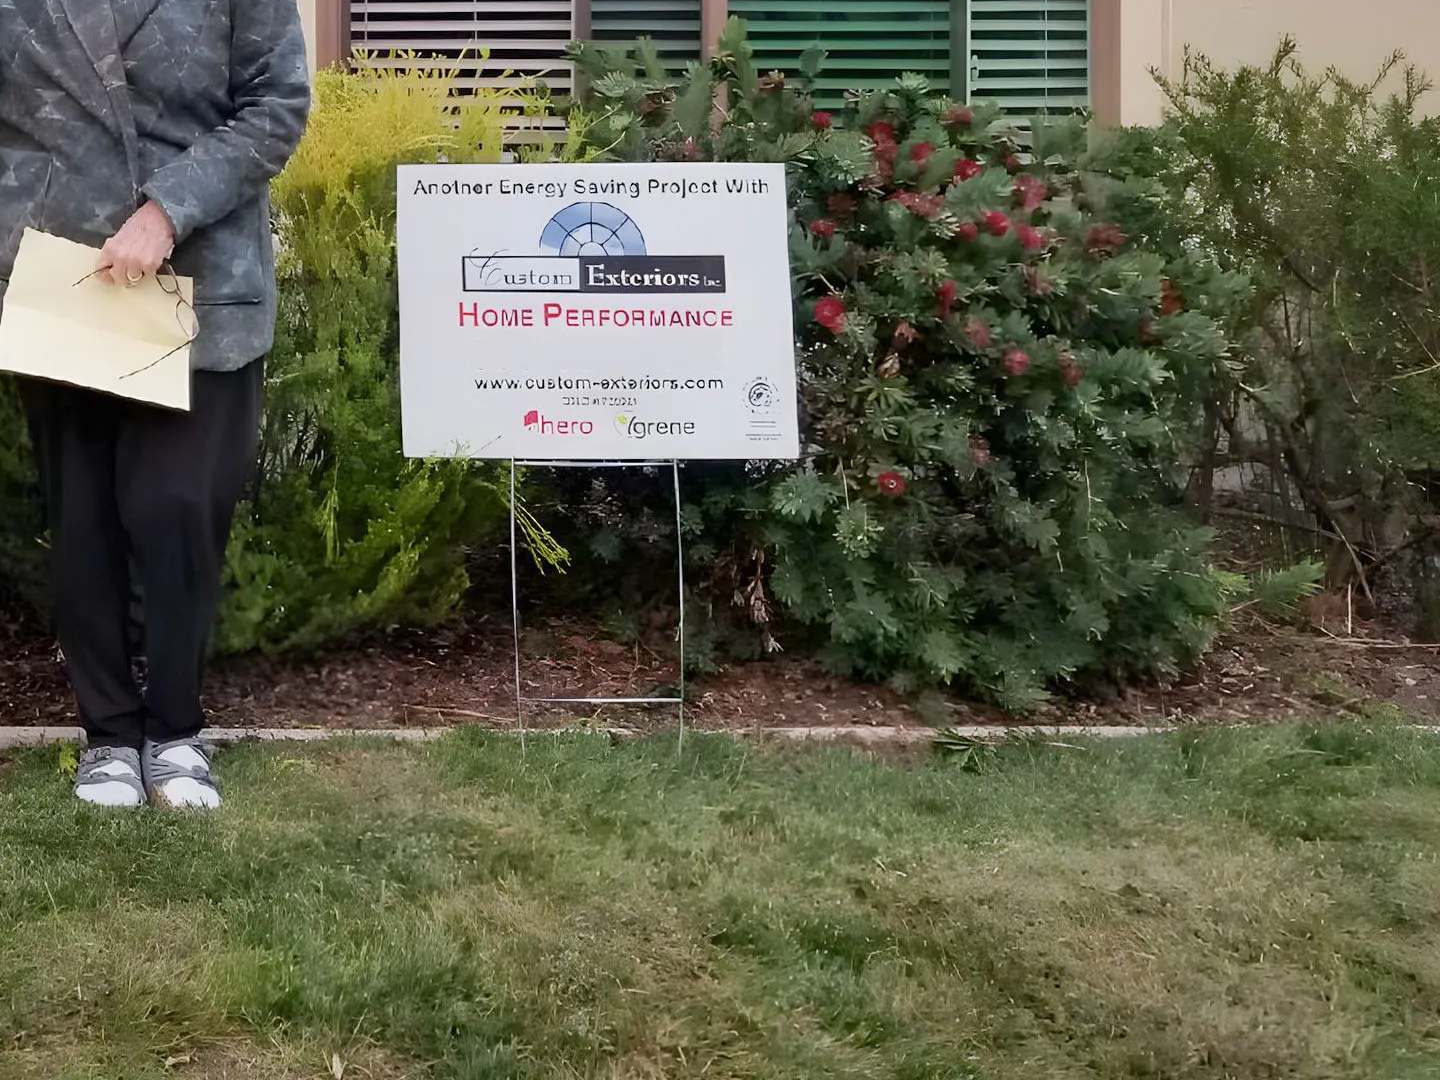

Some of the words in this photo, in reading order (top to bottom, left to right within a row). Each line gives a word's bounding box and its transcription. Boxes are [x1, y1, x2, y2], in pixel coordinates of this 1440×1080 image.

[412, 179, 493, 196] Another
[499, 178, 567, 199] Energy
[573, 178, 641, 199] Saving
[647, 177, 718, 199] Project
[726, 178, 769, 195] With
[469, 248, 573, 286] Custom
[586, 263, 700, 287] Exteriors
[458, 301, 534, 328] HOME
[542, 302, 734, 328] PERFORMANCE
[474, 373, 724, 391] www.custom-exteriors.com
[540, 413, 594, 435] hero
